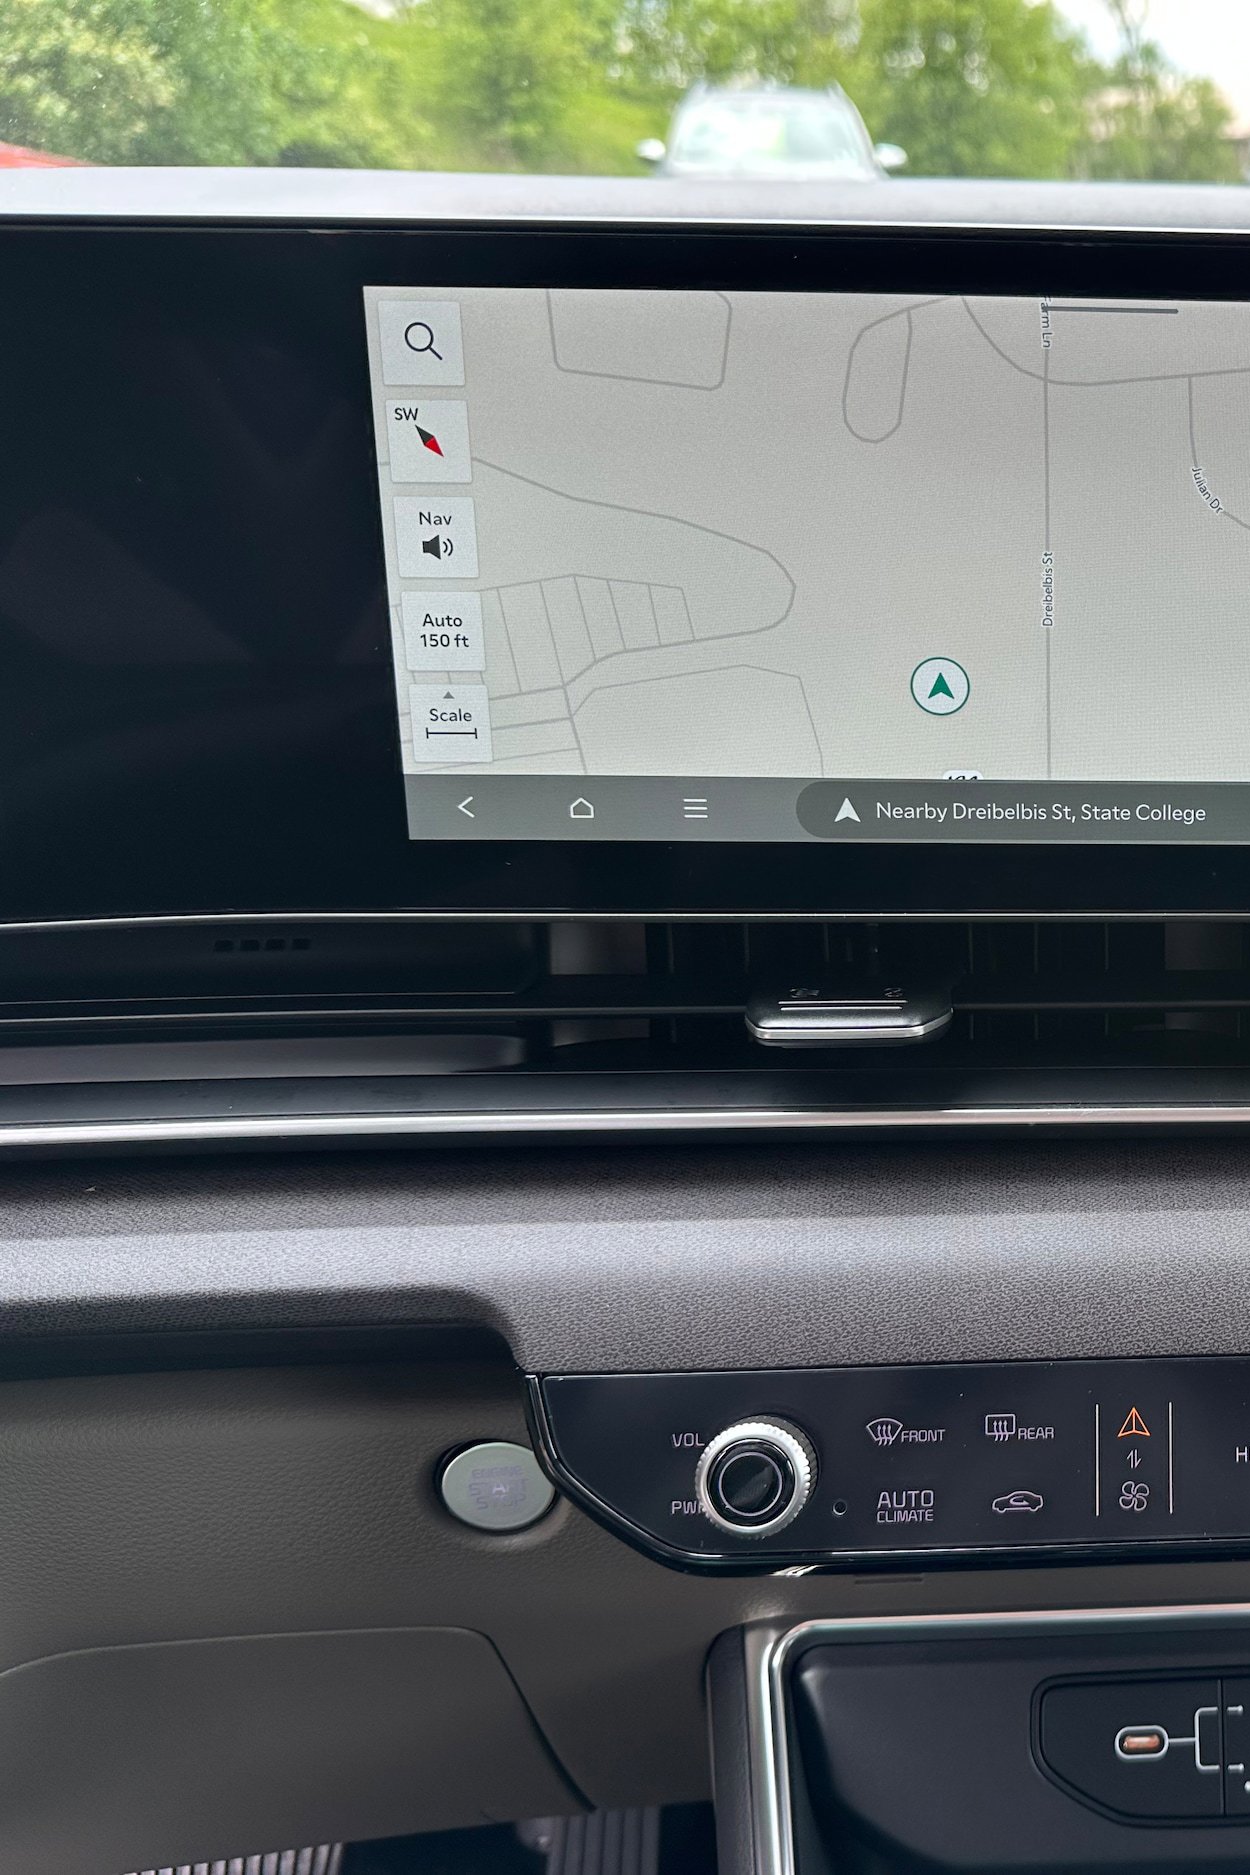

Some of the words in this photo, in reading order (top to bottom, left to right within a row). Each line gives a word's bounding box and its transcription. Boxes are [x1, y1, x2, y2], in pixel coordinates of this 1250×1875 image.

[1042, 332, 1054, 348] Ln
[394, 407, 419, 421] SW
[1191, 467, 1211, 501] Julian
[1209, 497, 1224, 514] Dr
[418, 511, 452, 526] Nav
[1041, 551, 1053, 565] St
[1042, 567, 1053, 627] Dreibelbis
[422, 613, 463, 628] Auto
[420, 633, 450, 648] 150
[453, 633, 470, 648] ft
[429, 708, 472, 722] Scale
[876, 801, 948, 823] Nearby
[952, 802, 1047, 820] Dreibelbis
[1051, 803, 1076, 824] St,
[1081, 803, 1131, 821] State
[1135, 803, 1206, 825] College
[671, 1432, 706, 1447] VOL
[901, 1428, 946, 1443] FRONT
[1017, 1426, 1055, 1440] REAR
[878, 1489, 934, 1509] AUTO
[671, 1500, 702, 1515] PW
[876, 1508, 934, 1524] CLIMATE
